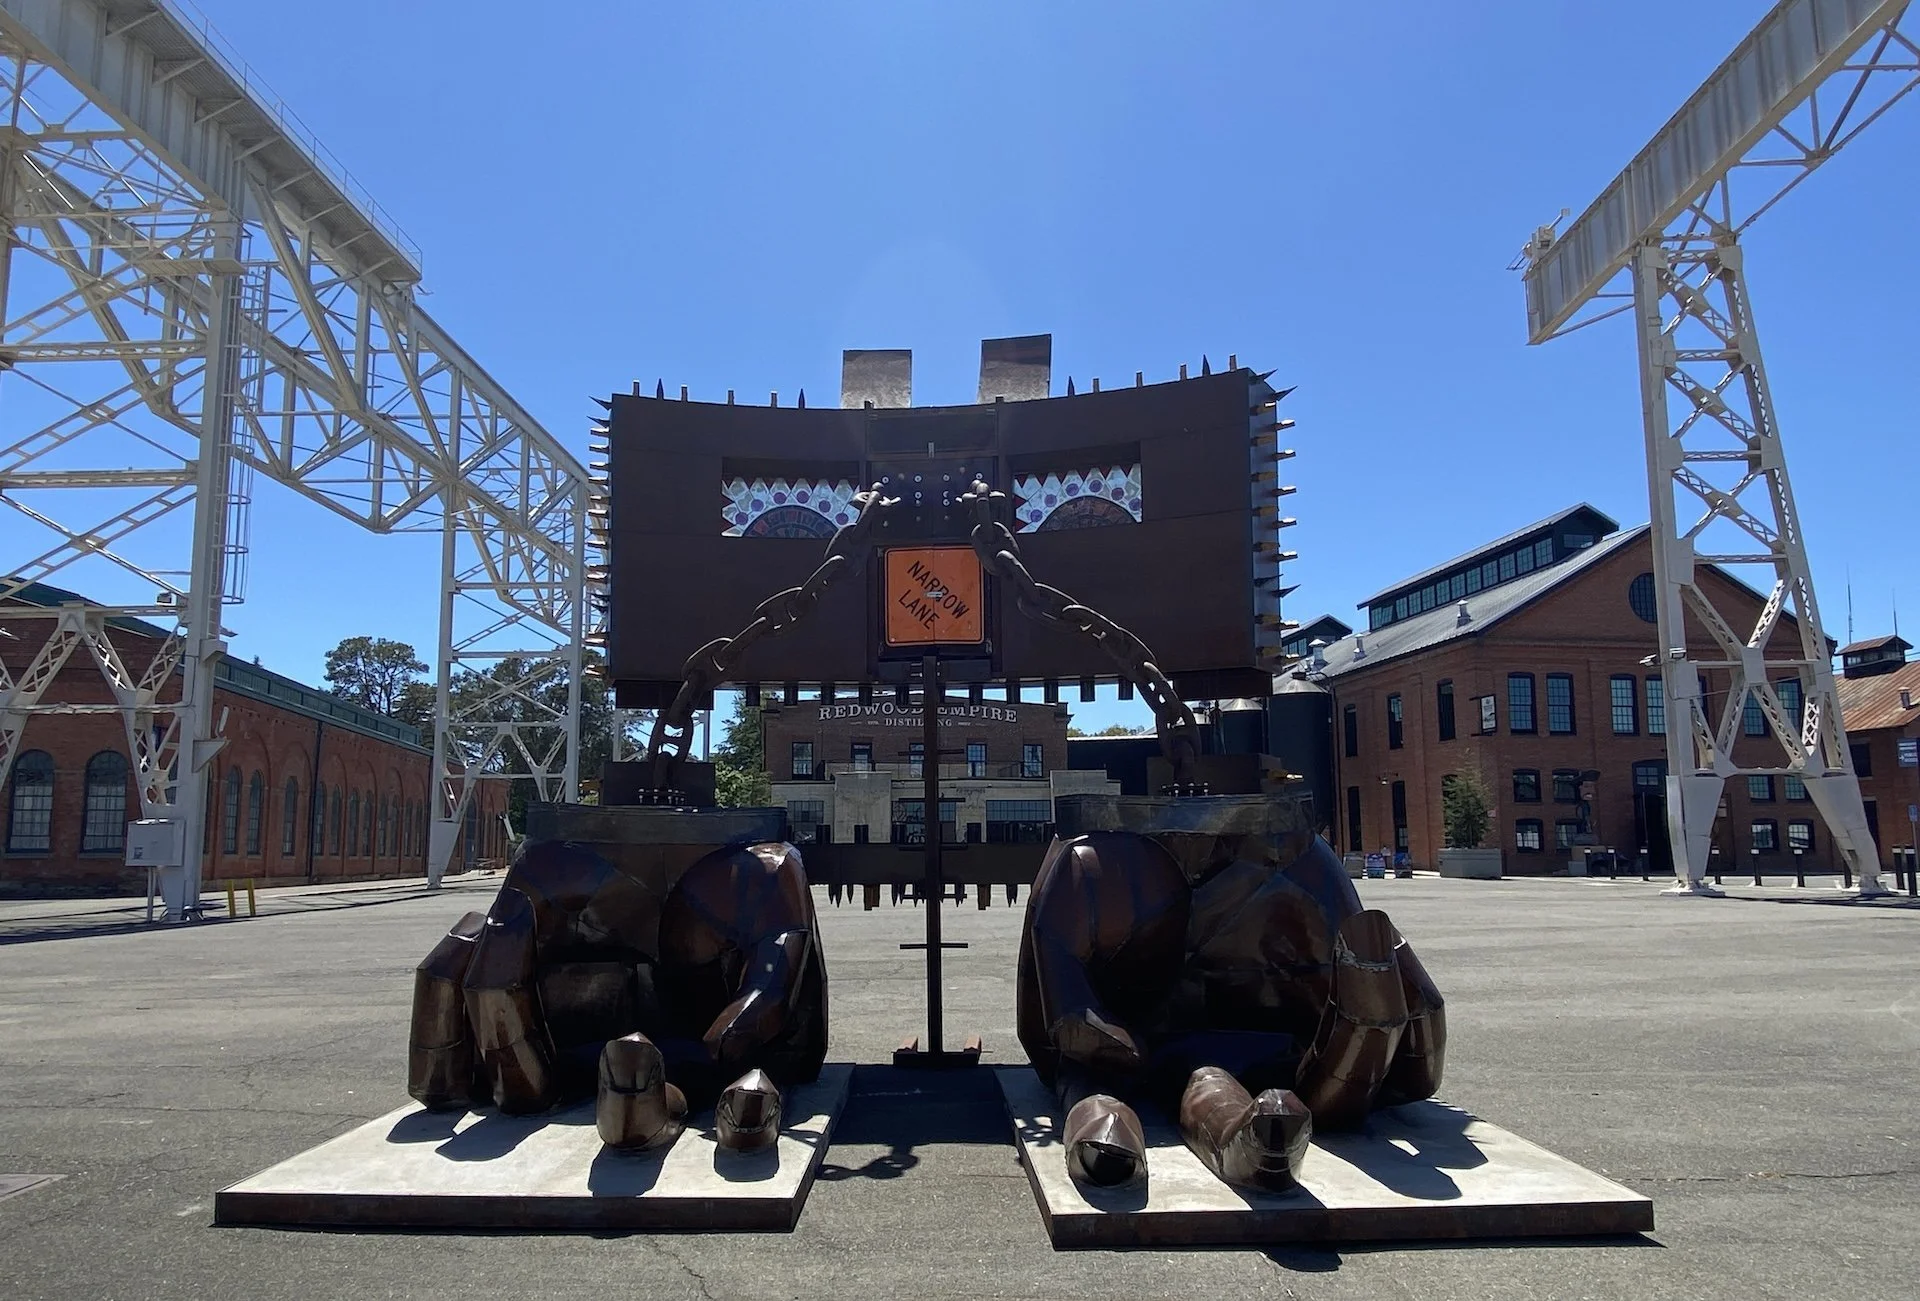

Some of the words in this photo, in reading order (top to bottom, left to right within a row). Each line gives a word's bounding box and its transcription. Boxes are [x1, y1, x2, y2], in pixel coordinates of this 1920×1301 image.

[907, 560, 970, 619] NARROW
[898, 589, 940, 630] LANE
[885, 718, 952, 727] DISTILNG
[936, 704, 1017, 723] EMPIRE
